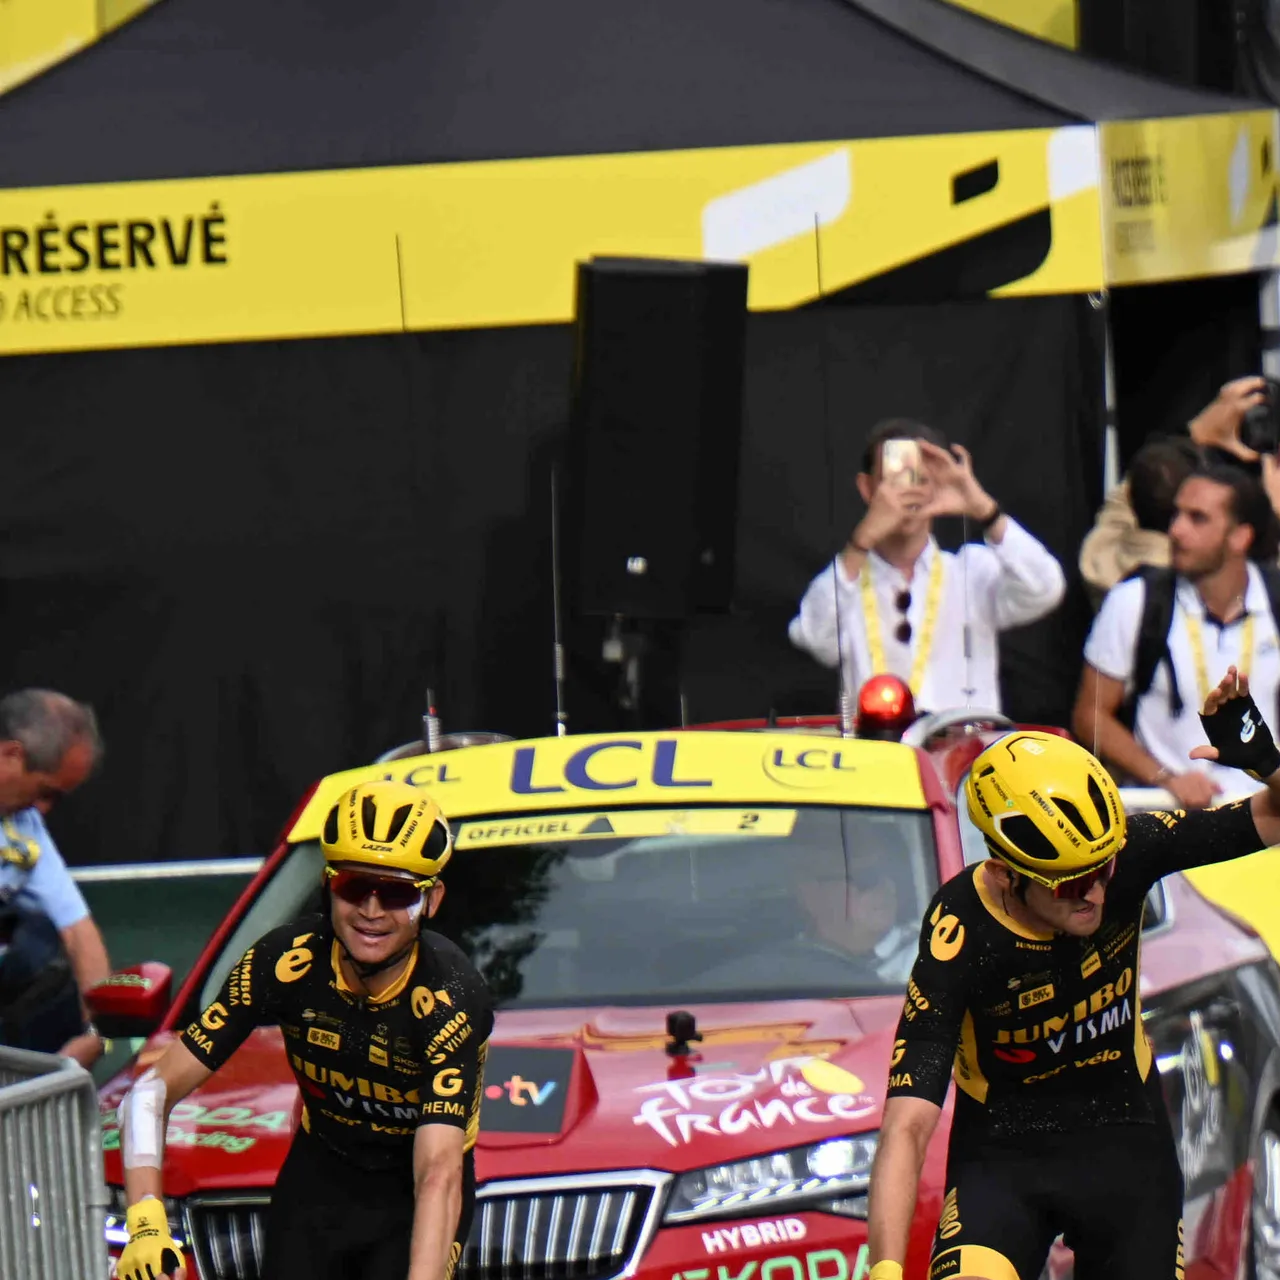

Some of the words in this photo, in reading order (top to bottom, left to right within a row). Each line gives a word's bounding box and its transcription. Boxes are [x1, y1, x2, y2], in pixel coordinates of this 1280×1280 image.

[0, 201, 228, 277] RÉSERVÉ
[13, 283, 124, 322] ACCESS
[509, 740, 713, 796] LCL
[772, 747, 856, 772] LCL
[974, 782, 993, 819] LAZER
[1028, 789, 1056, 819] JUMBO
[399, 820, 418, 848] JUMBO
[467, 820, 573, 841] OFFICIEL
[737, 813, 760, 831] 2
[1063, 828, 1082, 849] VISMA
[361, 843, 393, 852] LAZER
[1090, 836, 1116, 855] LAZER
[1015, 941, 1052, 951] JUMBO
[992, 967, 1133, 1044] JUMBO
[185, 1022, 216, 1056] EMA
[425, 1011, 469, 1057] JUMBO
[443, 1023, 474, 1053] VISMA
[1047, 997, 1132, 1054] VISMA
[320, 1039, 338, 1049] CITY
[432, 1067, 464, 1097] G
[780, 1075, 812, 1097] de
[333, 1091, 418, 1120] VISM
[422, 1100, 466, 1117] HEMA
[701, 1218, 807, 1255] HYBRID
[930, 1258, 958, 1277] HEMA
